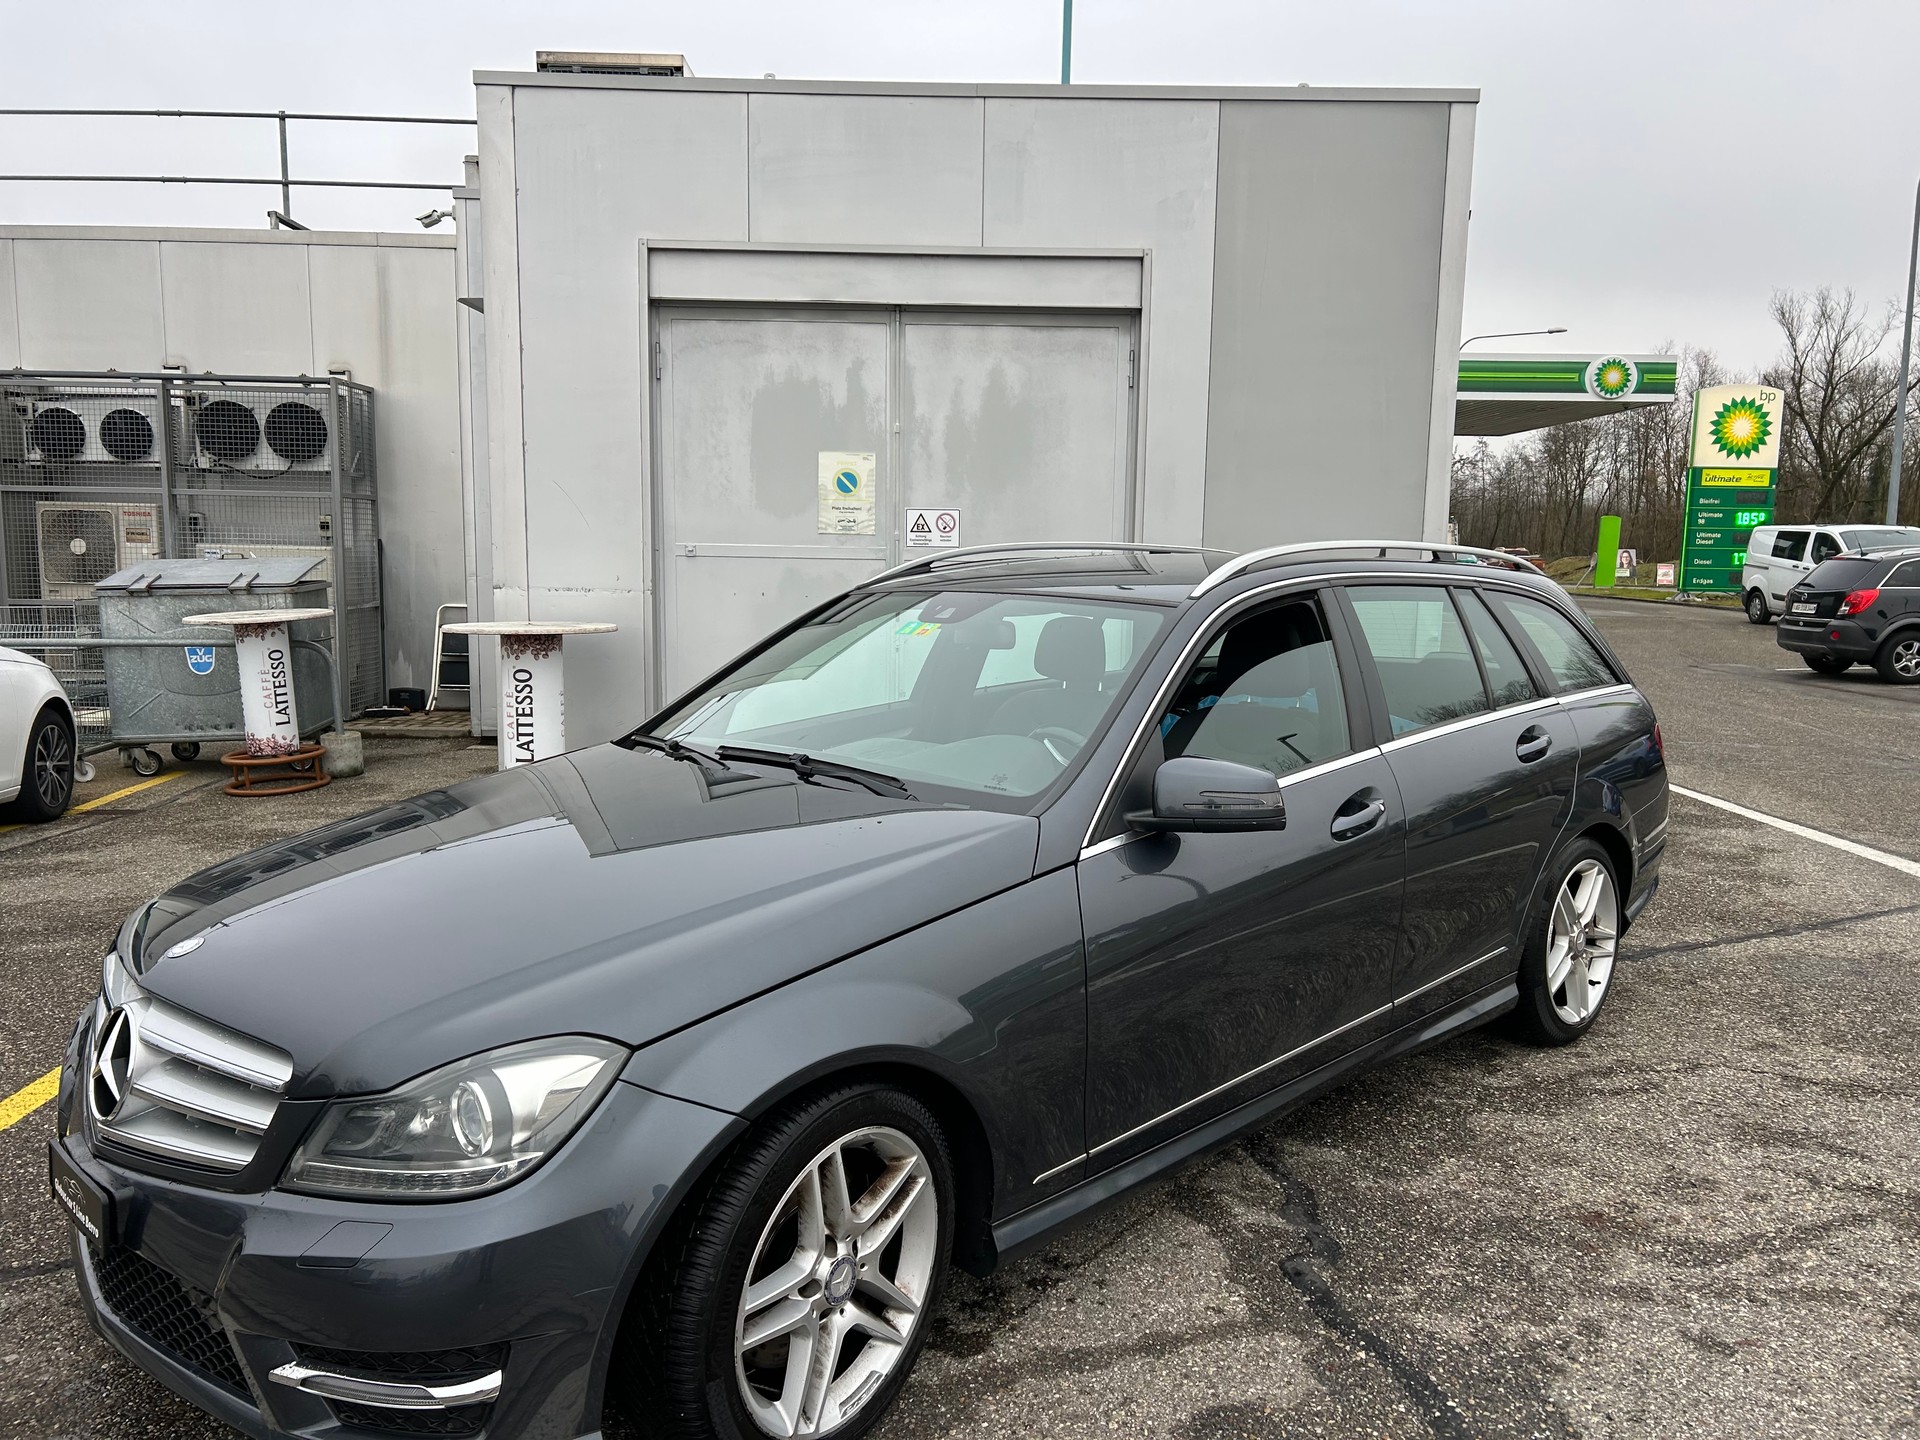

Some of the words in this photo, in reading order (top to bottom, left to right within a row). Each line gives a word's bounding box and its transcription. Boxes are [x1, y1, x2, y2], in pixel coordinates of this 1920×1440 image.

[1760, 389, 1776, 403] bp
[1704, 475, 1742, 483] ultimate
[916, 523, 926, 531] EX
[190, 655, 213, 663] ZUG
[268, 649, 291, 727] LATTESSO
[513, 668, 535, 763] LATTESSO
